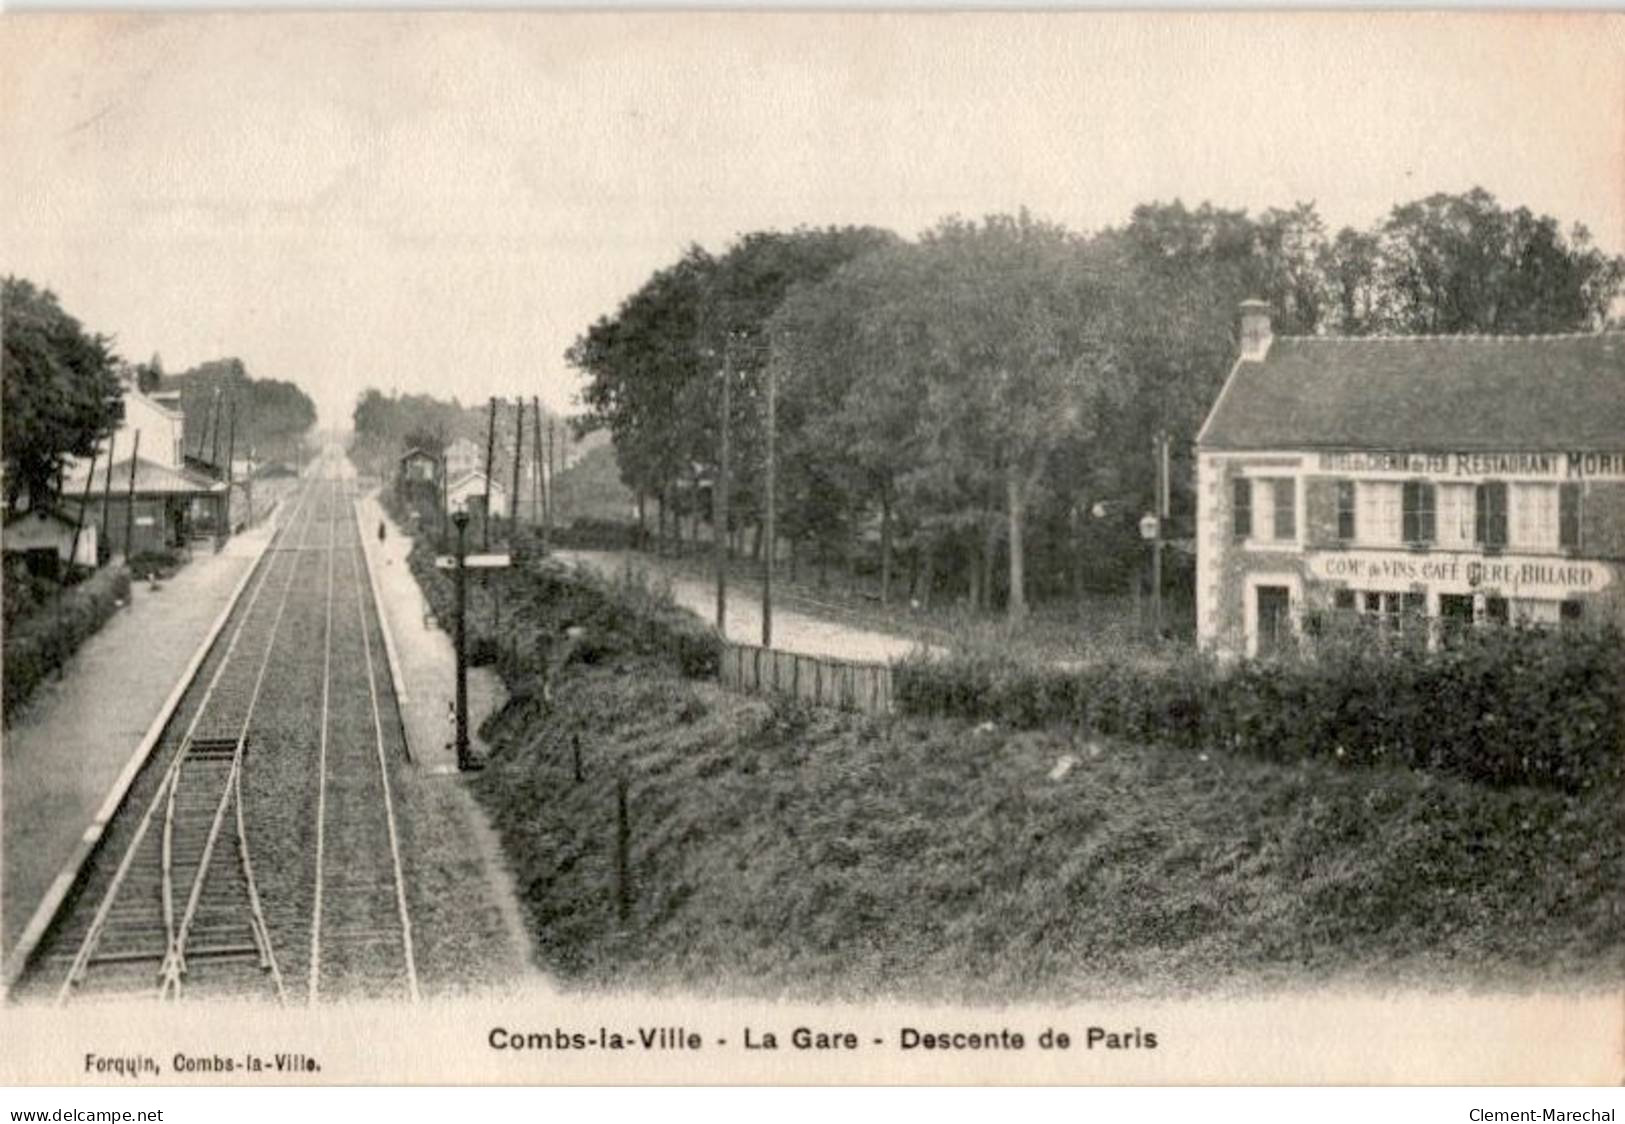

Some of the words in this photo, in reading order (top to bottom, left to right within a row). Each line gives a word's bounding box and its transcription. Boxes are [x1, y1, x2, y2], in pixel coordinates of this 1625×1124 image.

[1456, 453, 1558, 475] RESTAURANT
[1567, 452, 1625, 478] MORI
[1382, 560, 1416, 578] VINS
[1521, 563, 1594, 585] BILLARD
[488, 1027, 702, 1050] Combs-la-Ville
[743, 1027, 778, 1050] La
[791, 1027, 858, 1050] Gare
[900, 1027, 1025, 1050] Descente
[1038, 1027, 1071, 1050] de
[1087, 1027, 1158, 1050] Paris
[173, 1053, 321, 1073] Combs-la-Ville.
